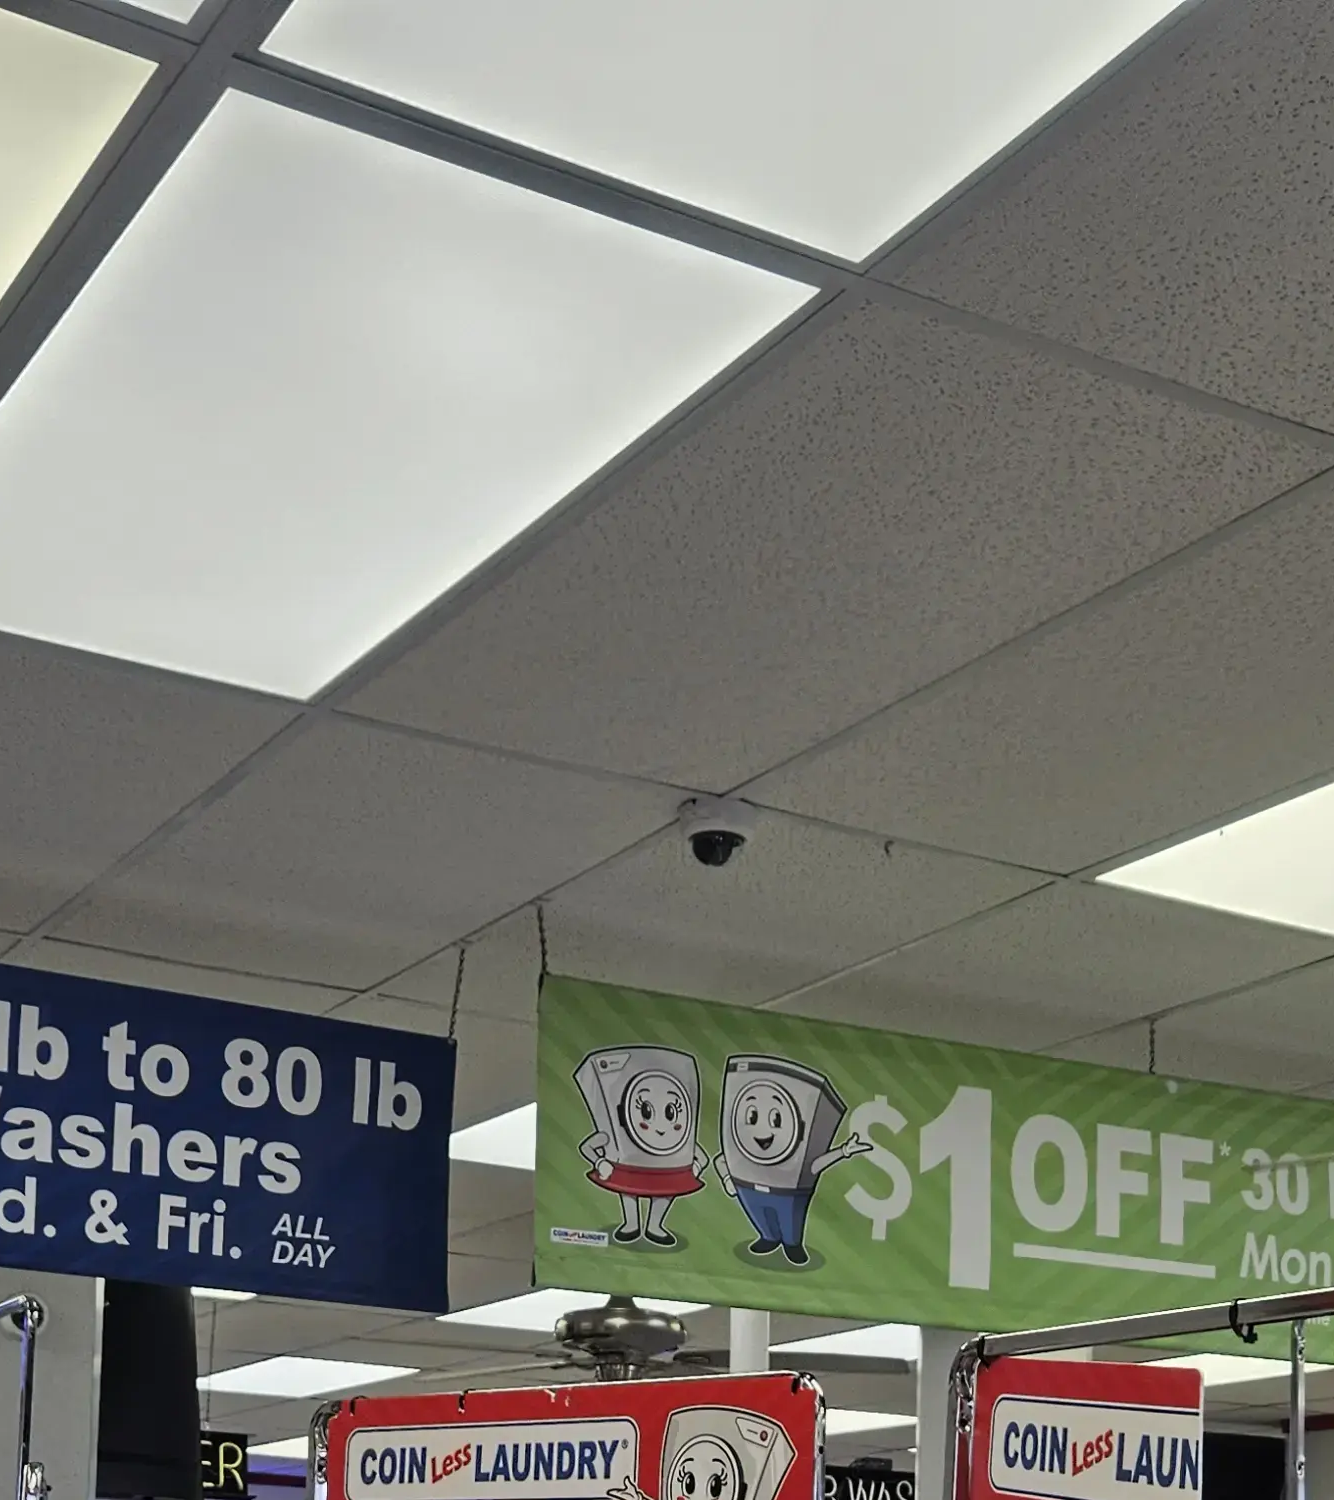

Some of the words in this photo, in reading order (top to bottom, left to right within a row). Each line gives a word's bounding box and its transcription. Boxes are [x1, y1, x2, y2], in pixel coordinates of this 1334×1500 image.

[102, 1021, 189, 1098] to
[222, 1040, 323, 1117] 80
[355, 1058, 423, 1132] lb
[845, 1086, 993, 1290] $1
[1240, 1149, 1312, 1217] 30
[84, 1189, 130, 1247] &
[157, 1196, 243, 1260] Fri.
[271, 1212, 332, 1243] ALL
[271, 1240, 336, 1270] DAY
[361, 1445, 427, 1485] COIN
[430, 1443, 472, 1484] Less
[474, 1439, 620, 1482] LAUNDRY
[1003, 1421, 1067, 1474] COIN
[1072, 1429, 1113, 1477] Less
